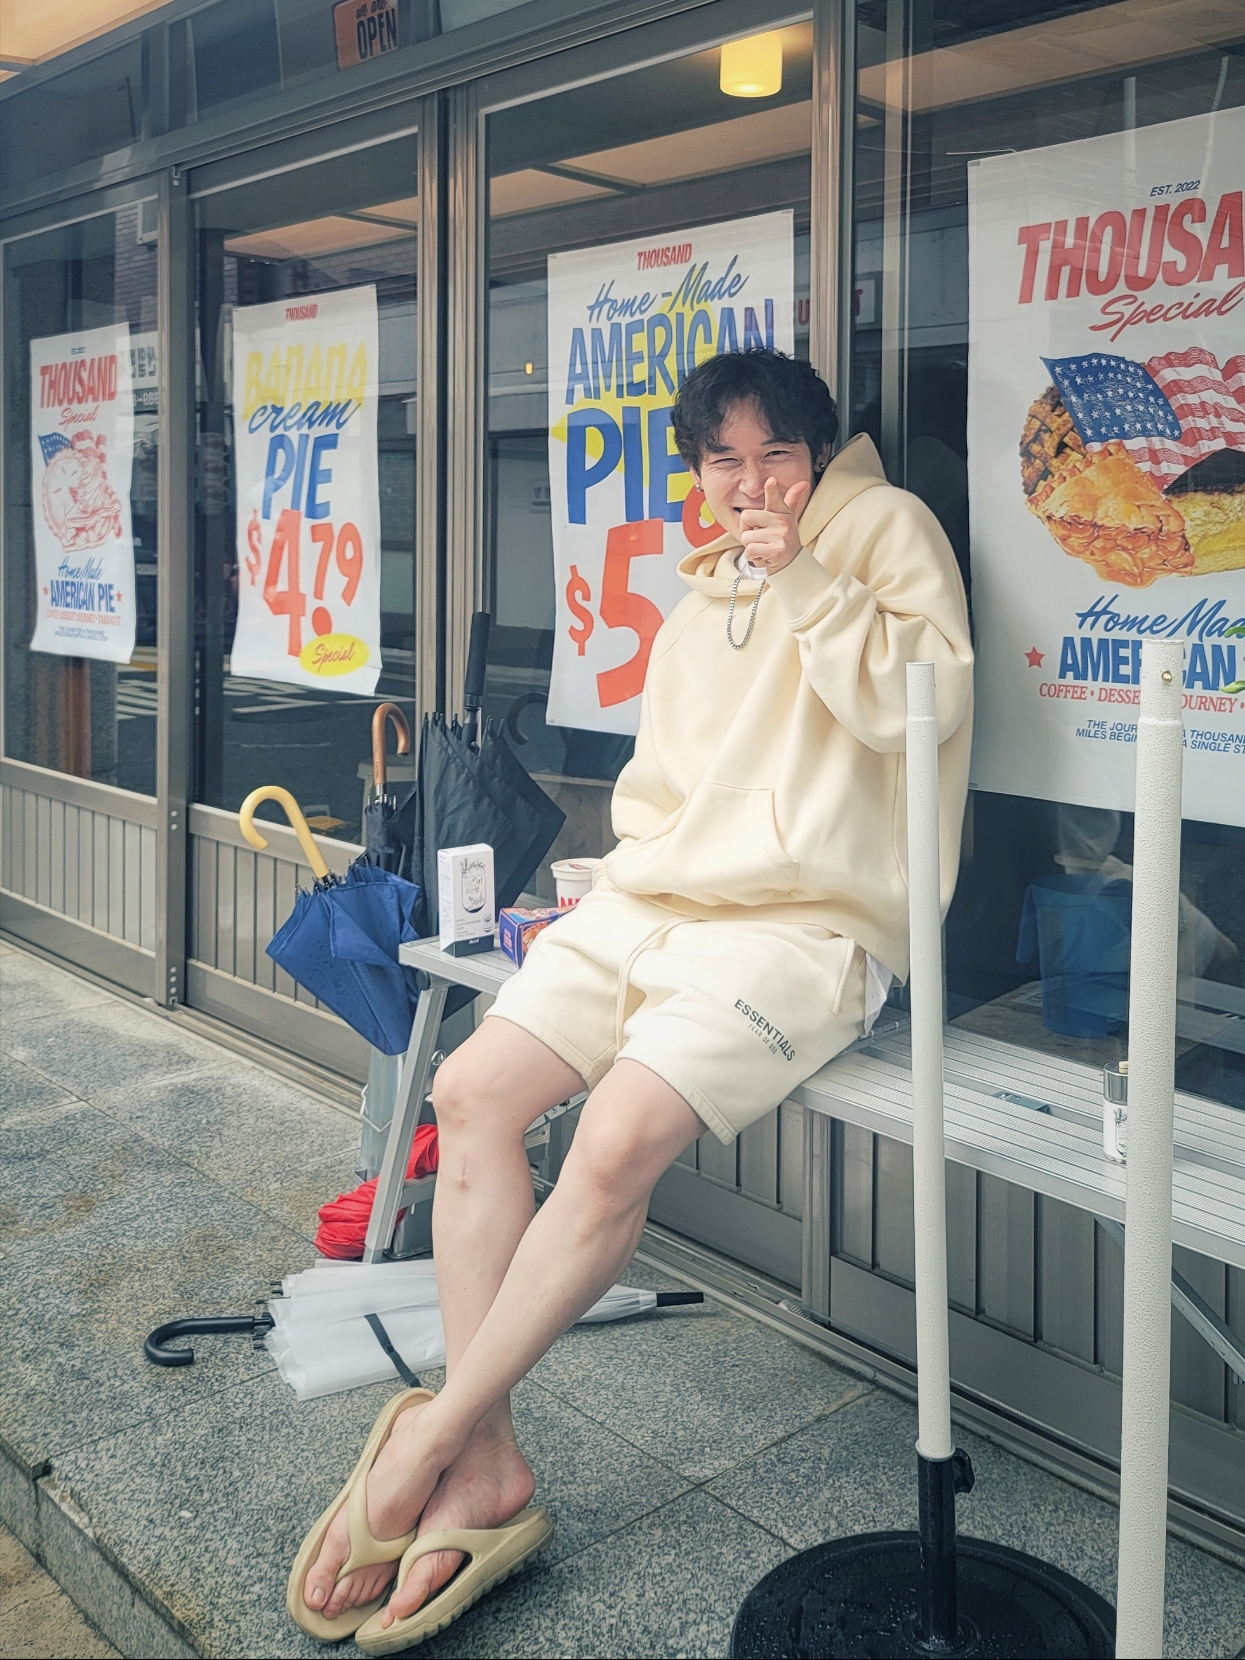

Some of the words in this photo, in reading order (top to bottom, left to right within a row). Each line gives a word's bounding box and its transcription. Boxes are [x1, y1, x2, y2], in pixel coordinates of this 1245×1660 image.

[357, 8, 397, 60] OPEN
[1149, 185, 1172, 197] EST.
[1174, 180, 1201, 194] 2022
[637, 243, 693, 271] THOUSAND
[284, 303, 319, 322] THOUSAND
[1088, 281, 1245, 342] Special
[40, 354, 117, 409] THOUSAND
[58, 405, 101, 432] Special
[248, 398, 362, 435] cream
[262, 433, 340, 520] PIE
[567, 406, 685, 525] PIE
[50, 579, 96, 612] AMERICAN
[98, 583, 115, 613] PIE
[312, 641, 356, 673] Special
[1039, 682, 1087, 700] COFFEE
[1097, 687, 1140, 706] DESSE
[1181, 694, 1238, 713] OURNEY
[1075, 728, 1107, 740] MILES
[1109, 731, 1137, 743] BEGI
[1190, 739, 1231, 752] SINGLE
[1086, 719, 1108, 731] THE
[1109, 722, 1137, 734] JOUR
[734, 998, 796, 1061] ESSENTIALS
[748, 1024, 762, 1037] FEAR
[762, 1035, 771, 1045] OF
